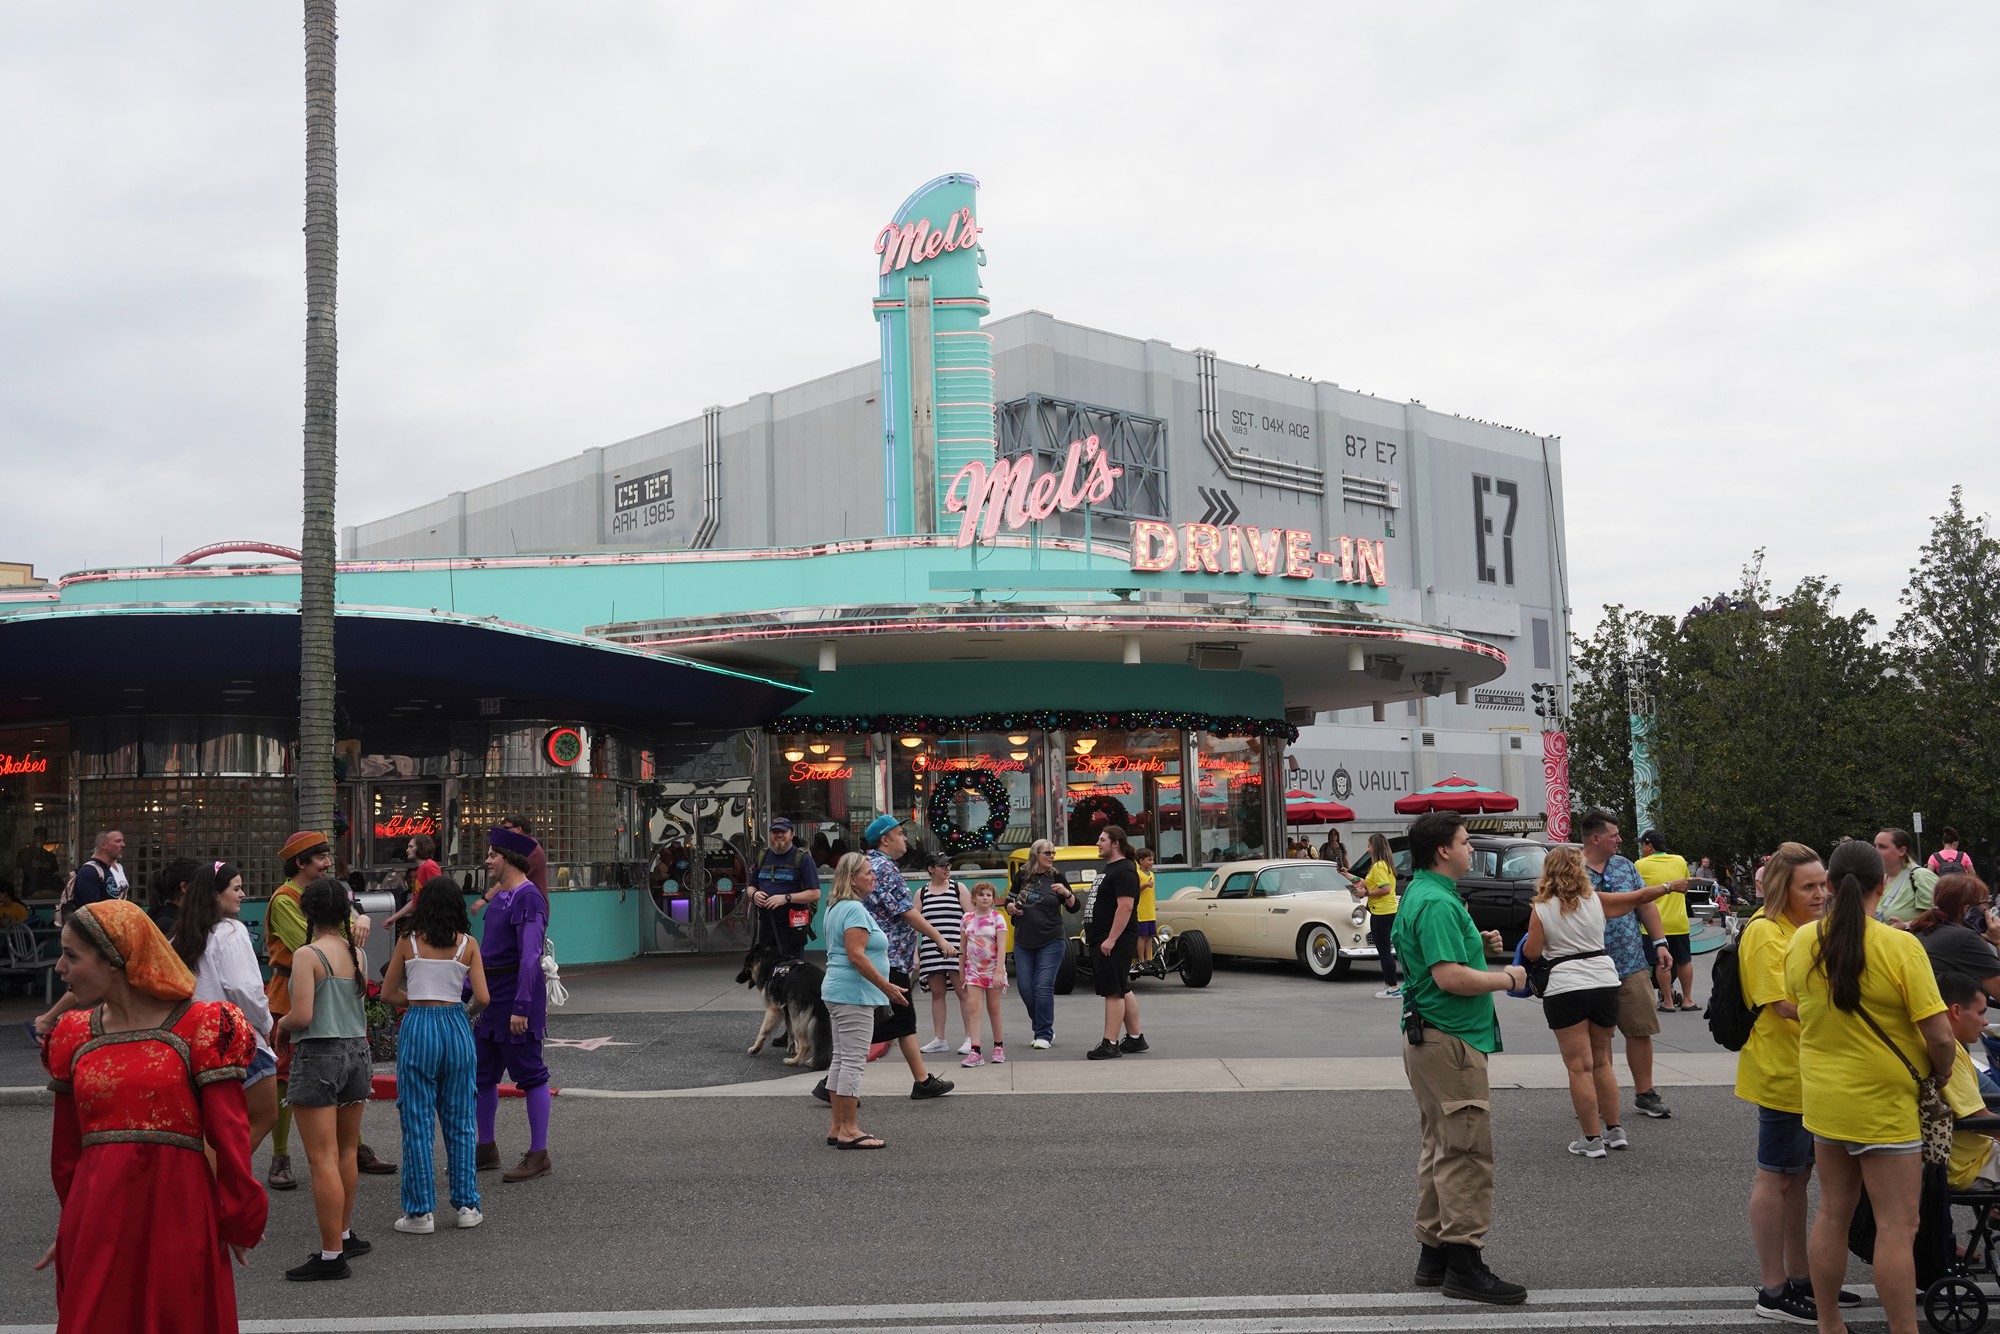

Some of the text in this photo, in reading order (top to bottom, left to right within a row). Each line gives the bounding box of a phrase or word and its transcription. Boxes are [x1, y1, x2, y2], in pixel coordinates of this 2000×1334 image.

[874, 206, 983, 277] Mel's
[1232, 410, 1258, 428] SCT.
[1345, 434, 1397, 465] 87 E7
[618, 474, 669, 508] CS 127
[945, 433, 1123, 550] Mel's
[613, 499, 675, 535] ARK 1985
[1472, 472, 1518, 588] E7
[1133, 520, 1386, 587] DRIVE-IN
[1477, 695, 1522, 705] KEEP AREA CLEAR
[789, 762, 853, 782] Shakes
[911, 753, 1025, 778] Chicken Fingers
[1074, 754, 1166, 777] Soft Drinks
[1359, 770, 1410, 791] VAULT
[386, 815, 435, 836] Chili
[1502, 821, 1543, 829] SUPPLY VAULT
